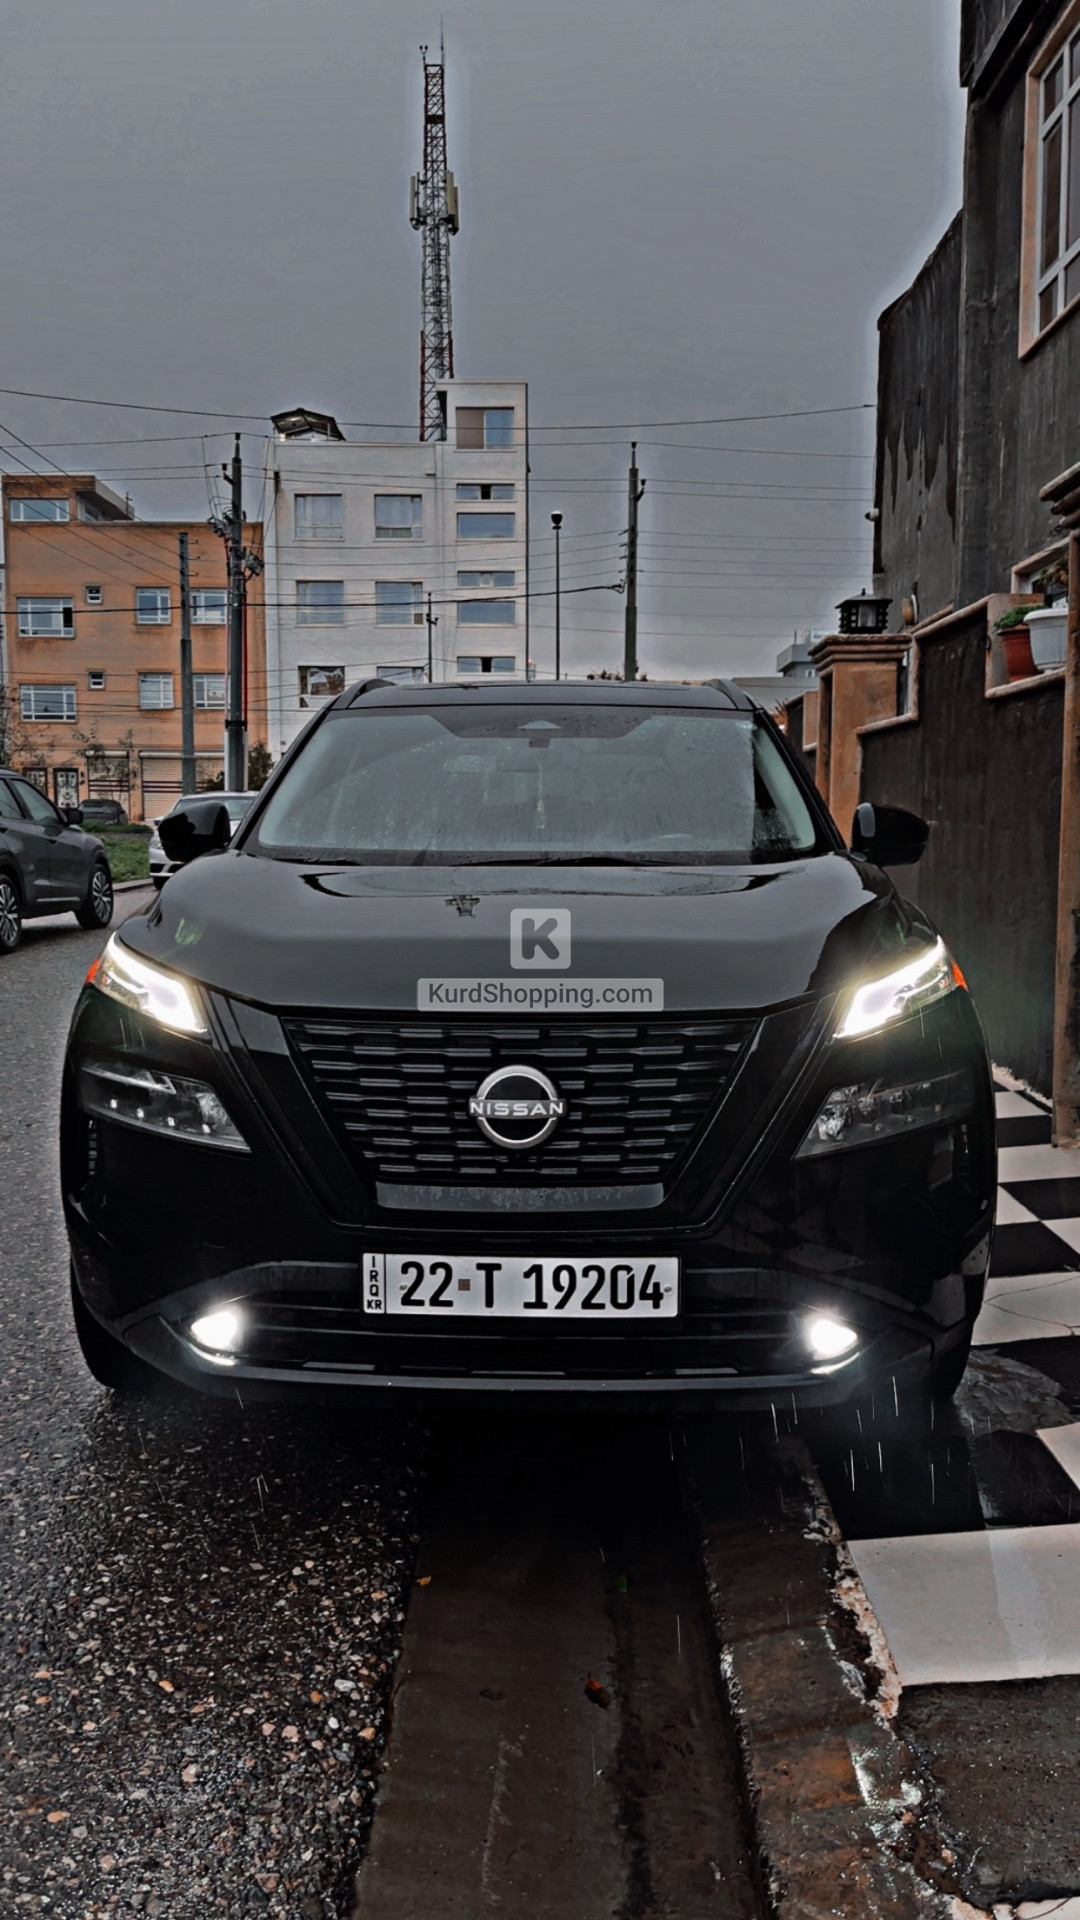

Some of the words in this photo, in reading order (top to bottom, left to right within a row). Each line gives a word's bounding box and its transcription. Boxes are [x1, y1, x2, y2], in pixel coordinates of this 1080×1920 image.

[470, 1102, 563, 1116] NISSAN
[400, 1260, 454, 1308] 22
[475, 1262, 502, 1309] T
[522, 1263, 664, 1310] 19204
[366, 1298, 382, 1310] KR
